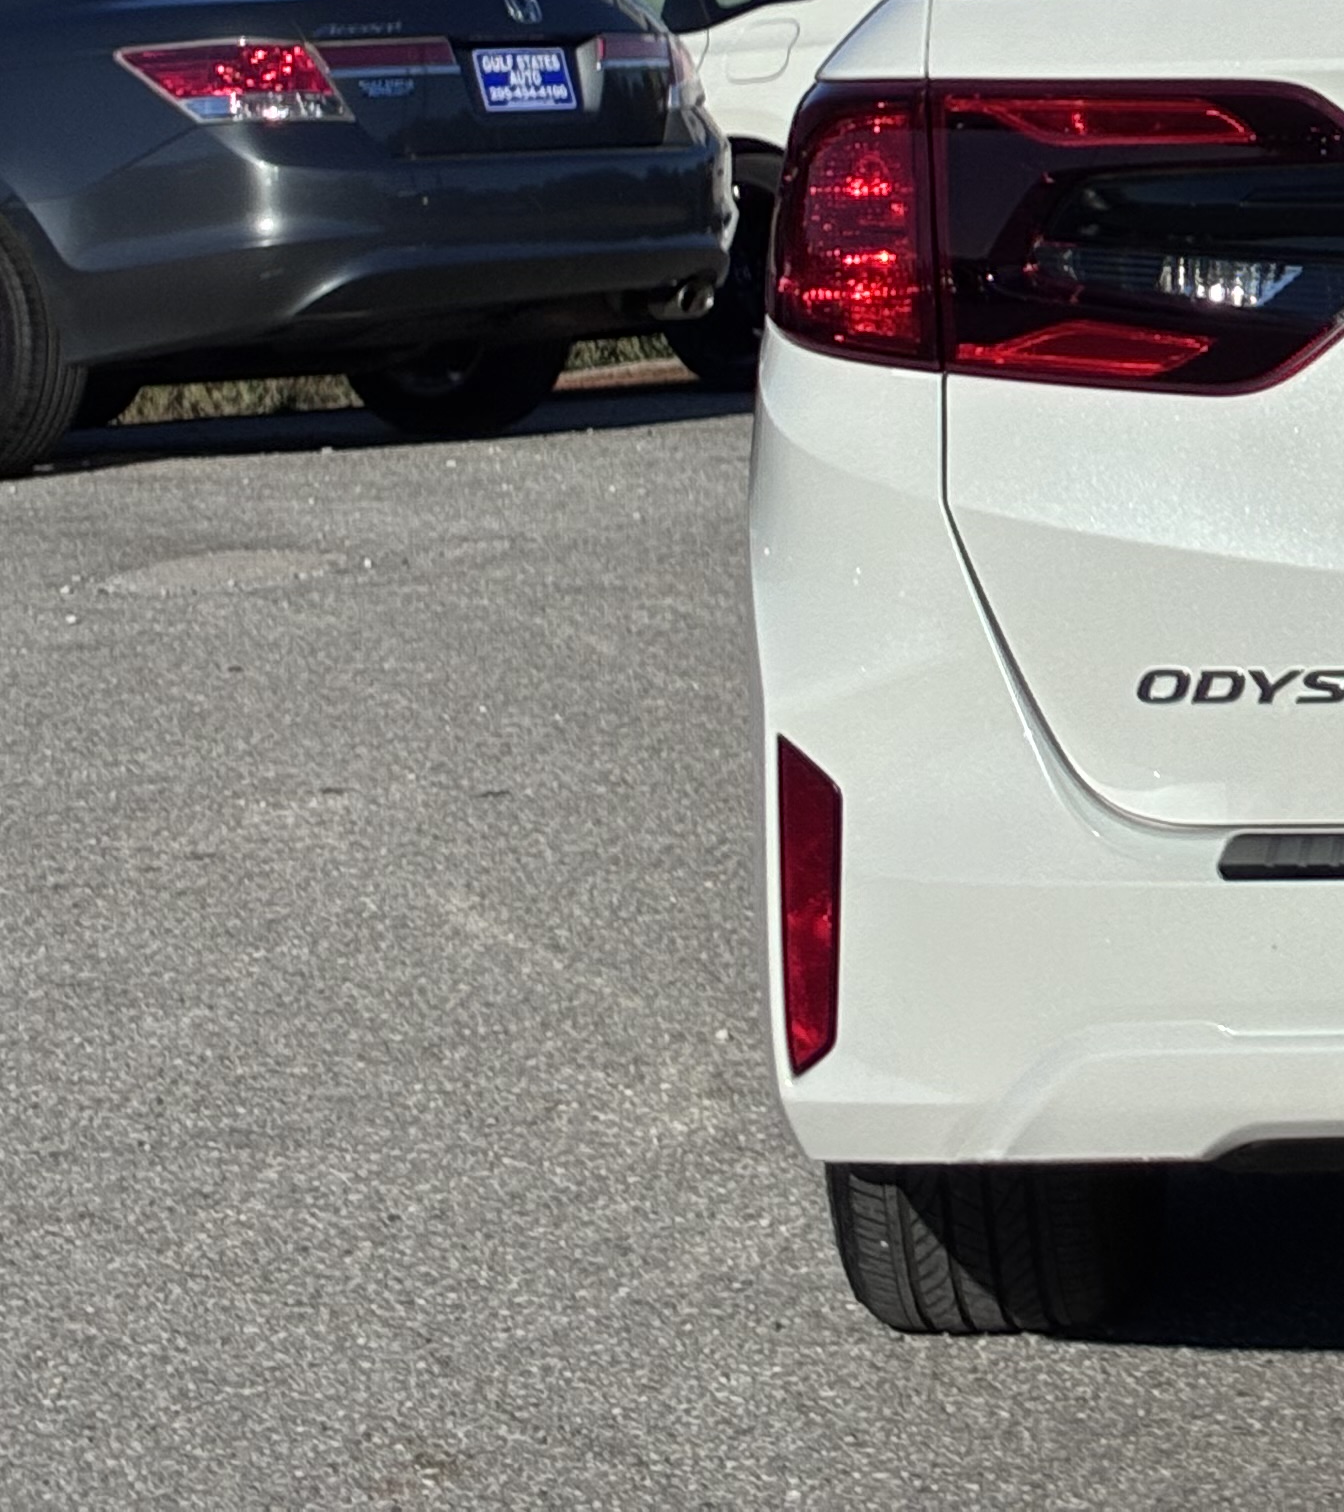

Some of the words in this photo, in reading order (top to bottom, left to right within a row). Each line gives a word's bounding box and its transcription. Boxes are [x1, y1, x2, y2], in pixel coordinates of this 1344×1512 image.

[482, 54, 513, 73] GULF
[516, 54, 561, 72] STATES
[510, 69, 542, 86] AUTO
